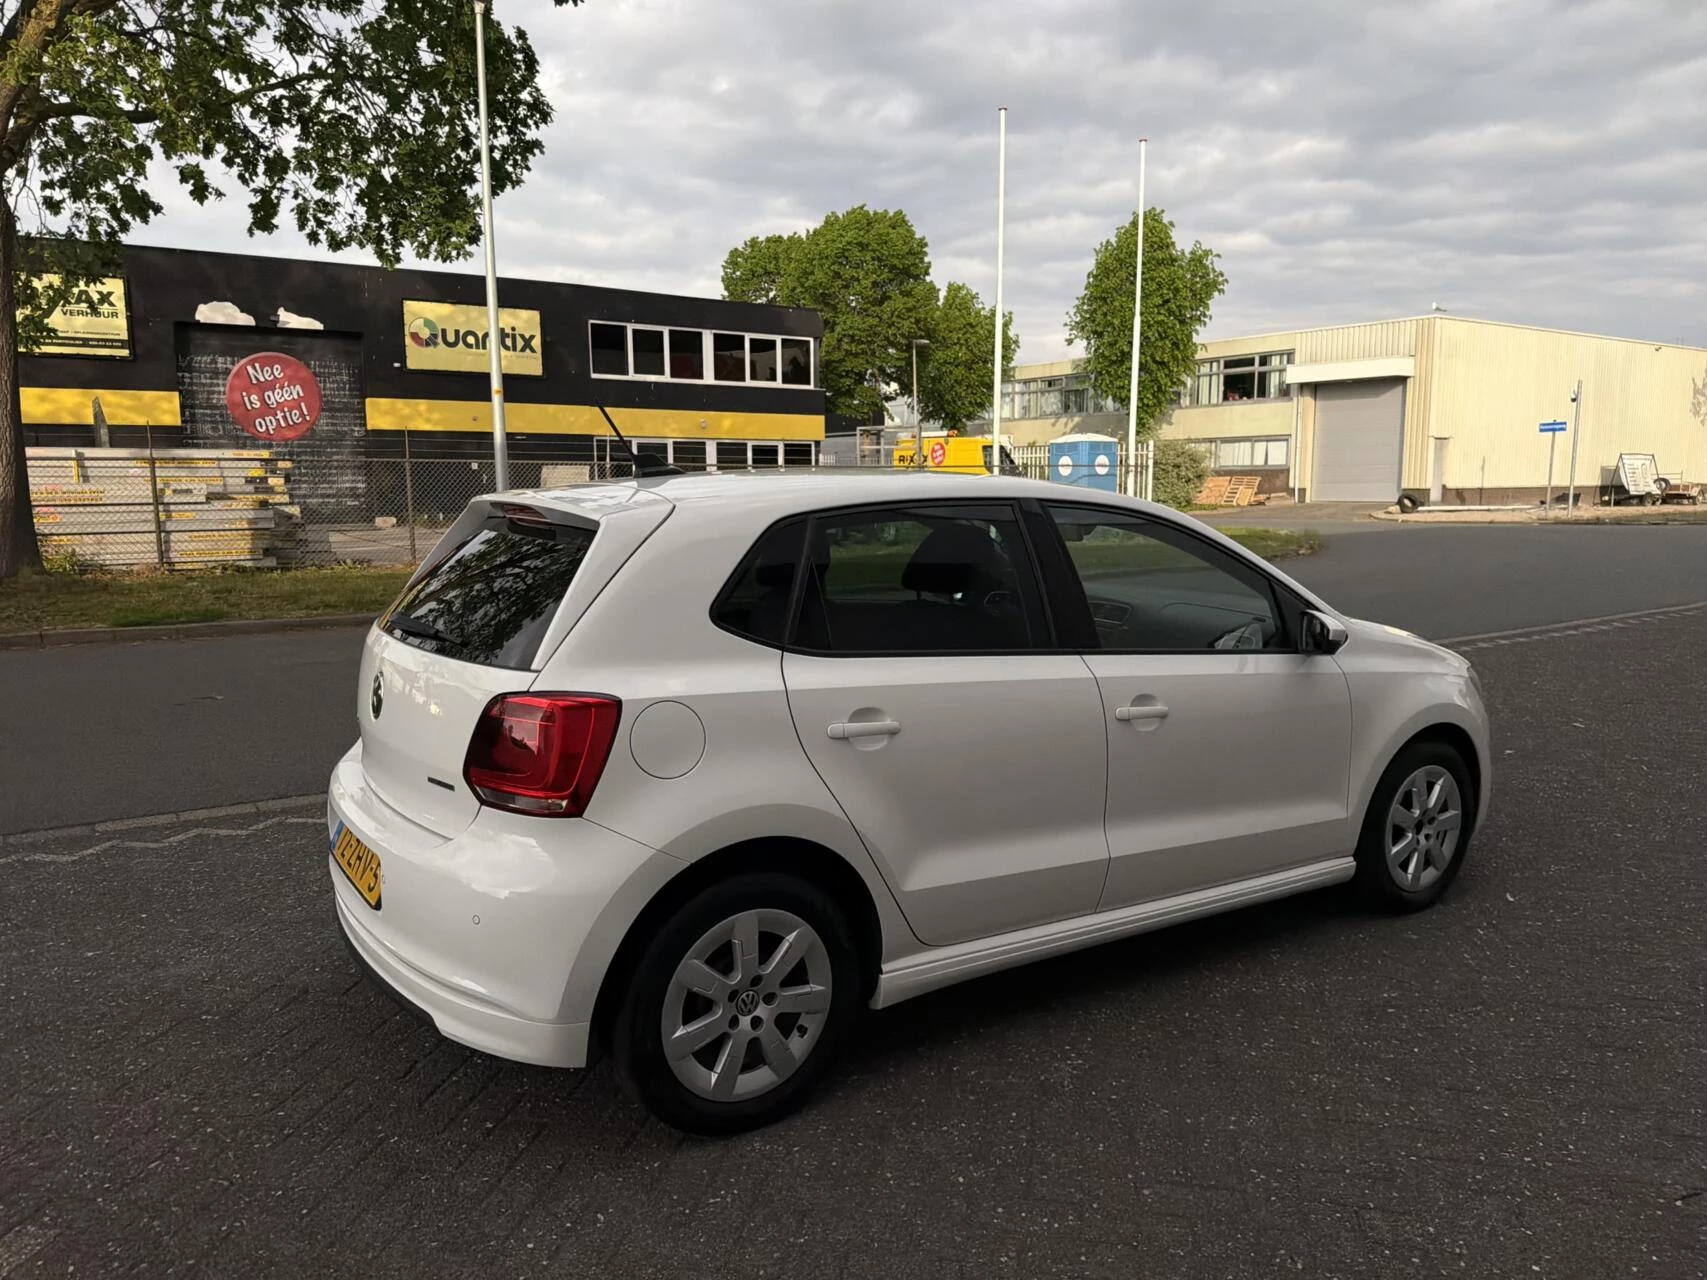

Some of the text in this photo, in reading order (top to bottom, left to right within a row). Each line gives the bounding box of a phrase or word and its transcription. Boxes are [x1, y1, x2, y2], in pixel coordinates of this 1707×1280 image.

[246, 363, 284, 384] Nee
[242, 381, 304, 410] is géén
[255, 402, 310, 434] optie!
